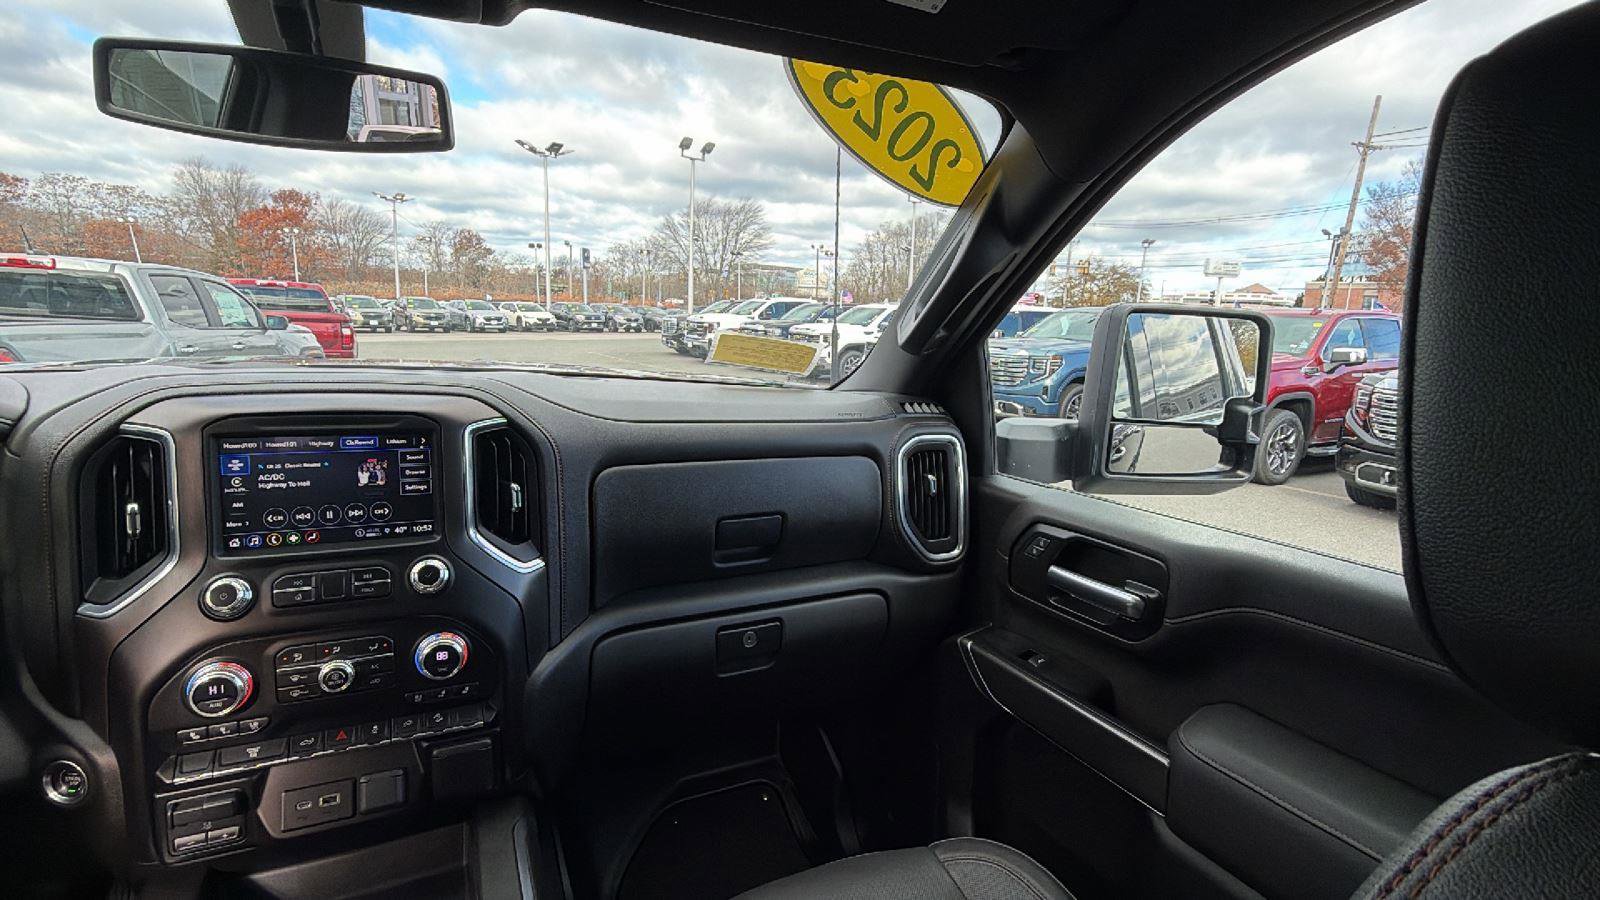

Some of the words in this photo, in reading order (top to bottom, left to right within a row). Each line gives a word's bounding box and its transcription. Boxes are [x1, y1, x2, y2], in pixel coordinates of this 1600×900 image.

[308, 440, 335, 448] Highway
[258, 473, 285, 481] AC/DC
[258, 481, 288, 490] Highway
[208, 684, 225, 696] HI
